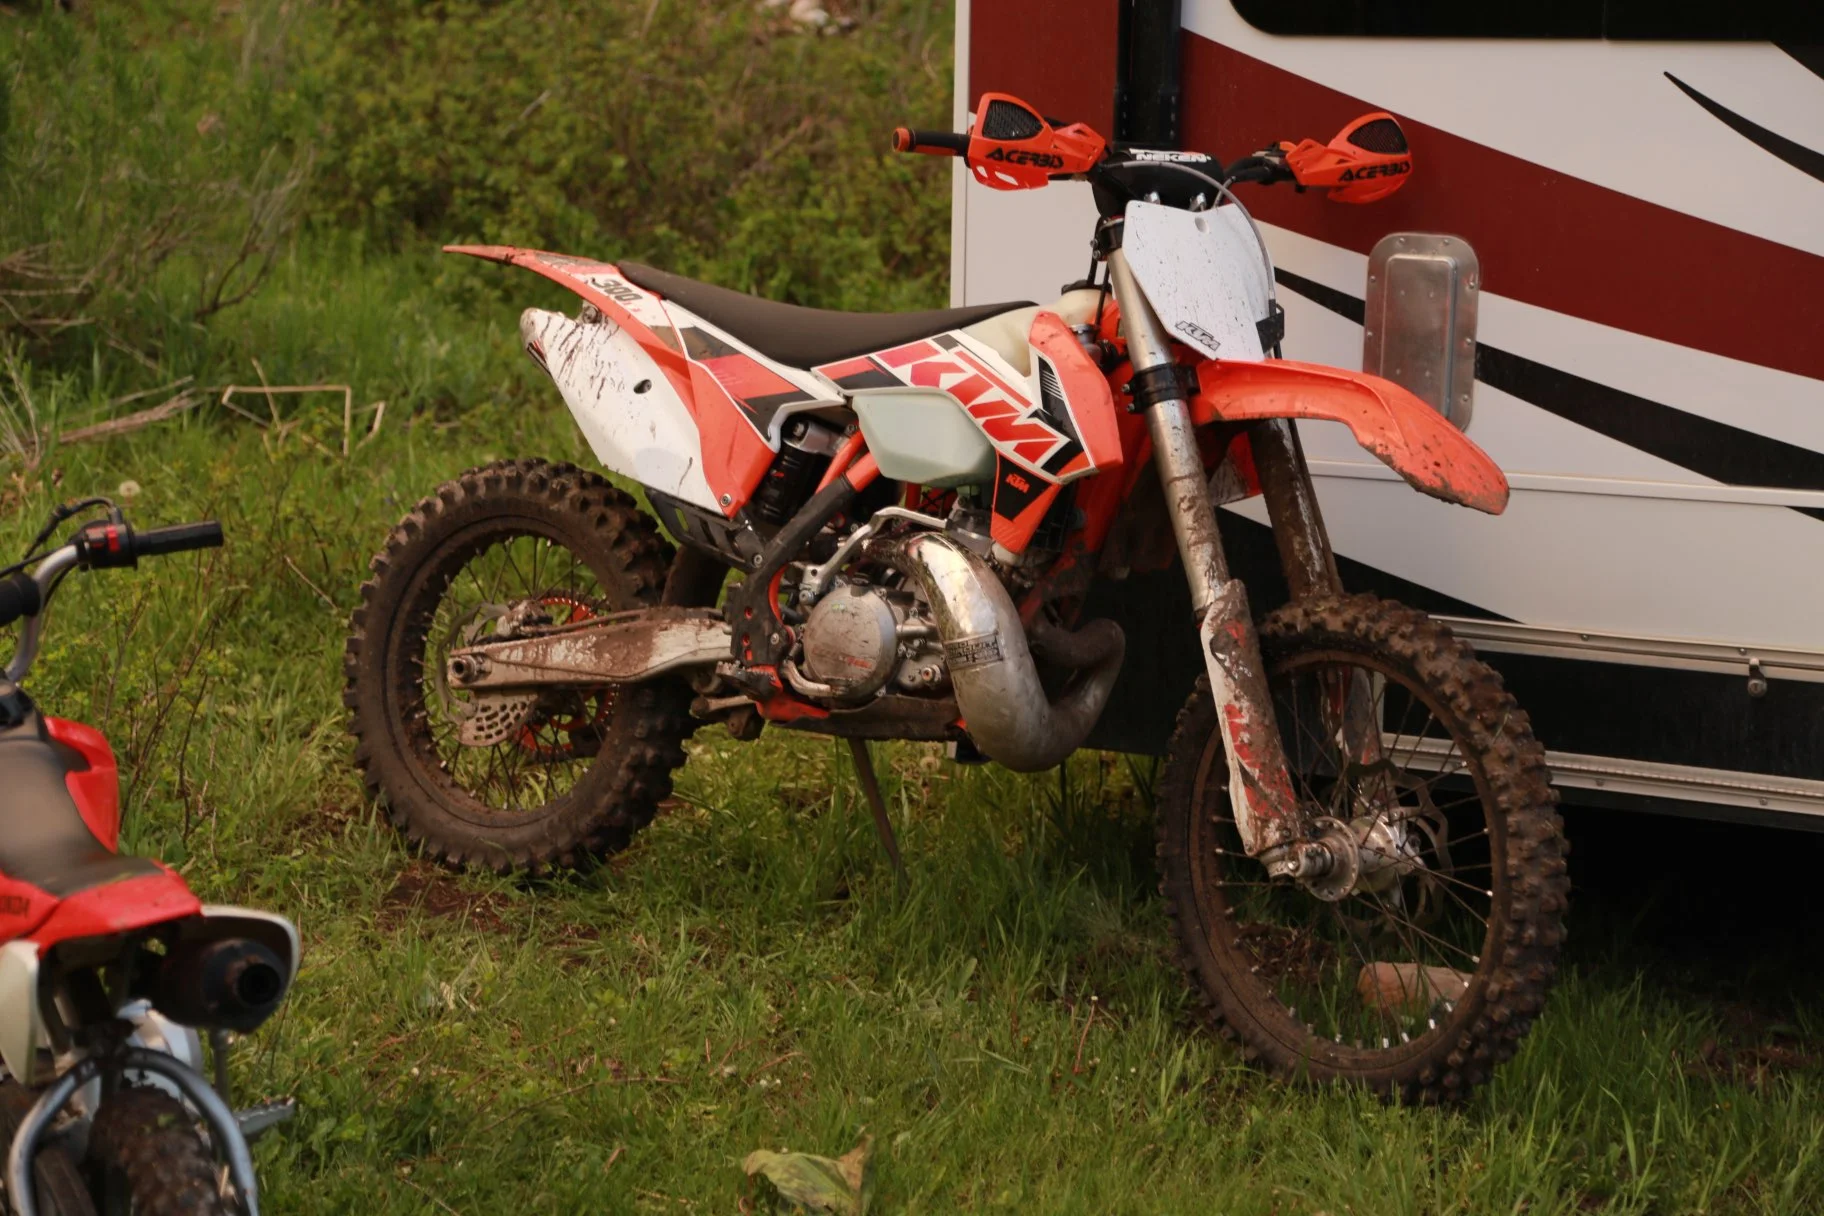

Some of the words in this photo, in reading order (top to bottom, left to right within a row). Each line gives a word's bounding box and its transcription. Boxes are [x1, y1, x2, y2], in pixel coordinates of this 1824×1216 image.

[591, 277, 643, 302] 300
[1175, 320, 1221, 351] KTM
[873, 341, 1061, 464] KTM
[1006, 473, 1030, 493] KTM
